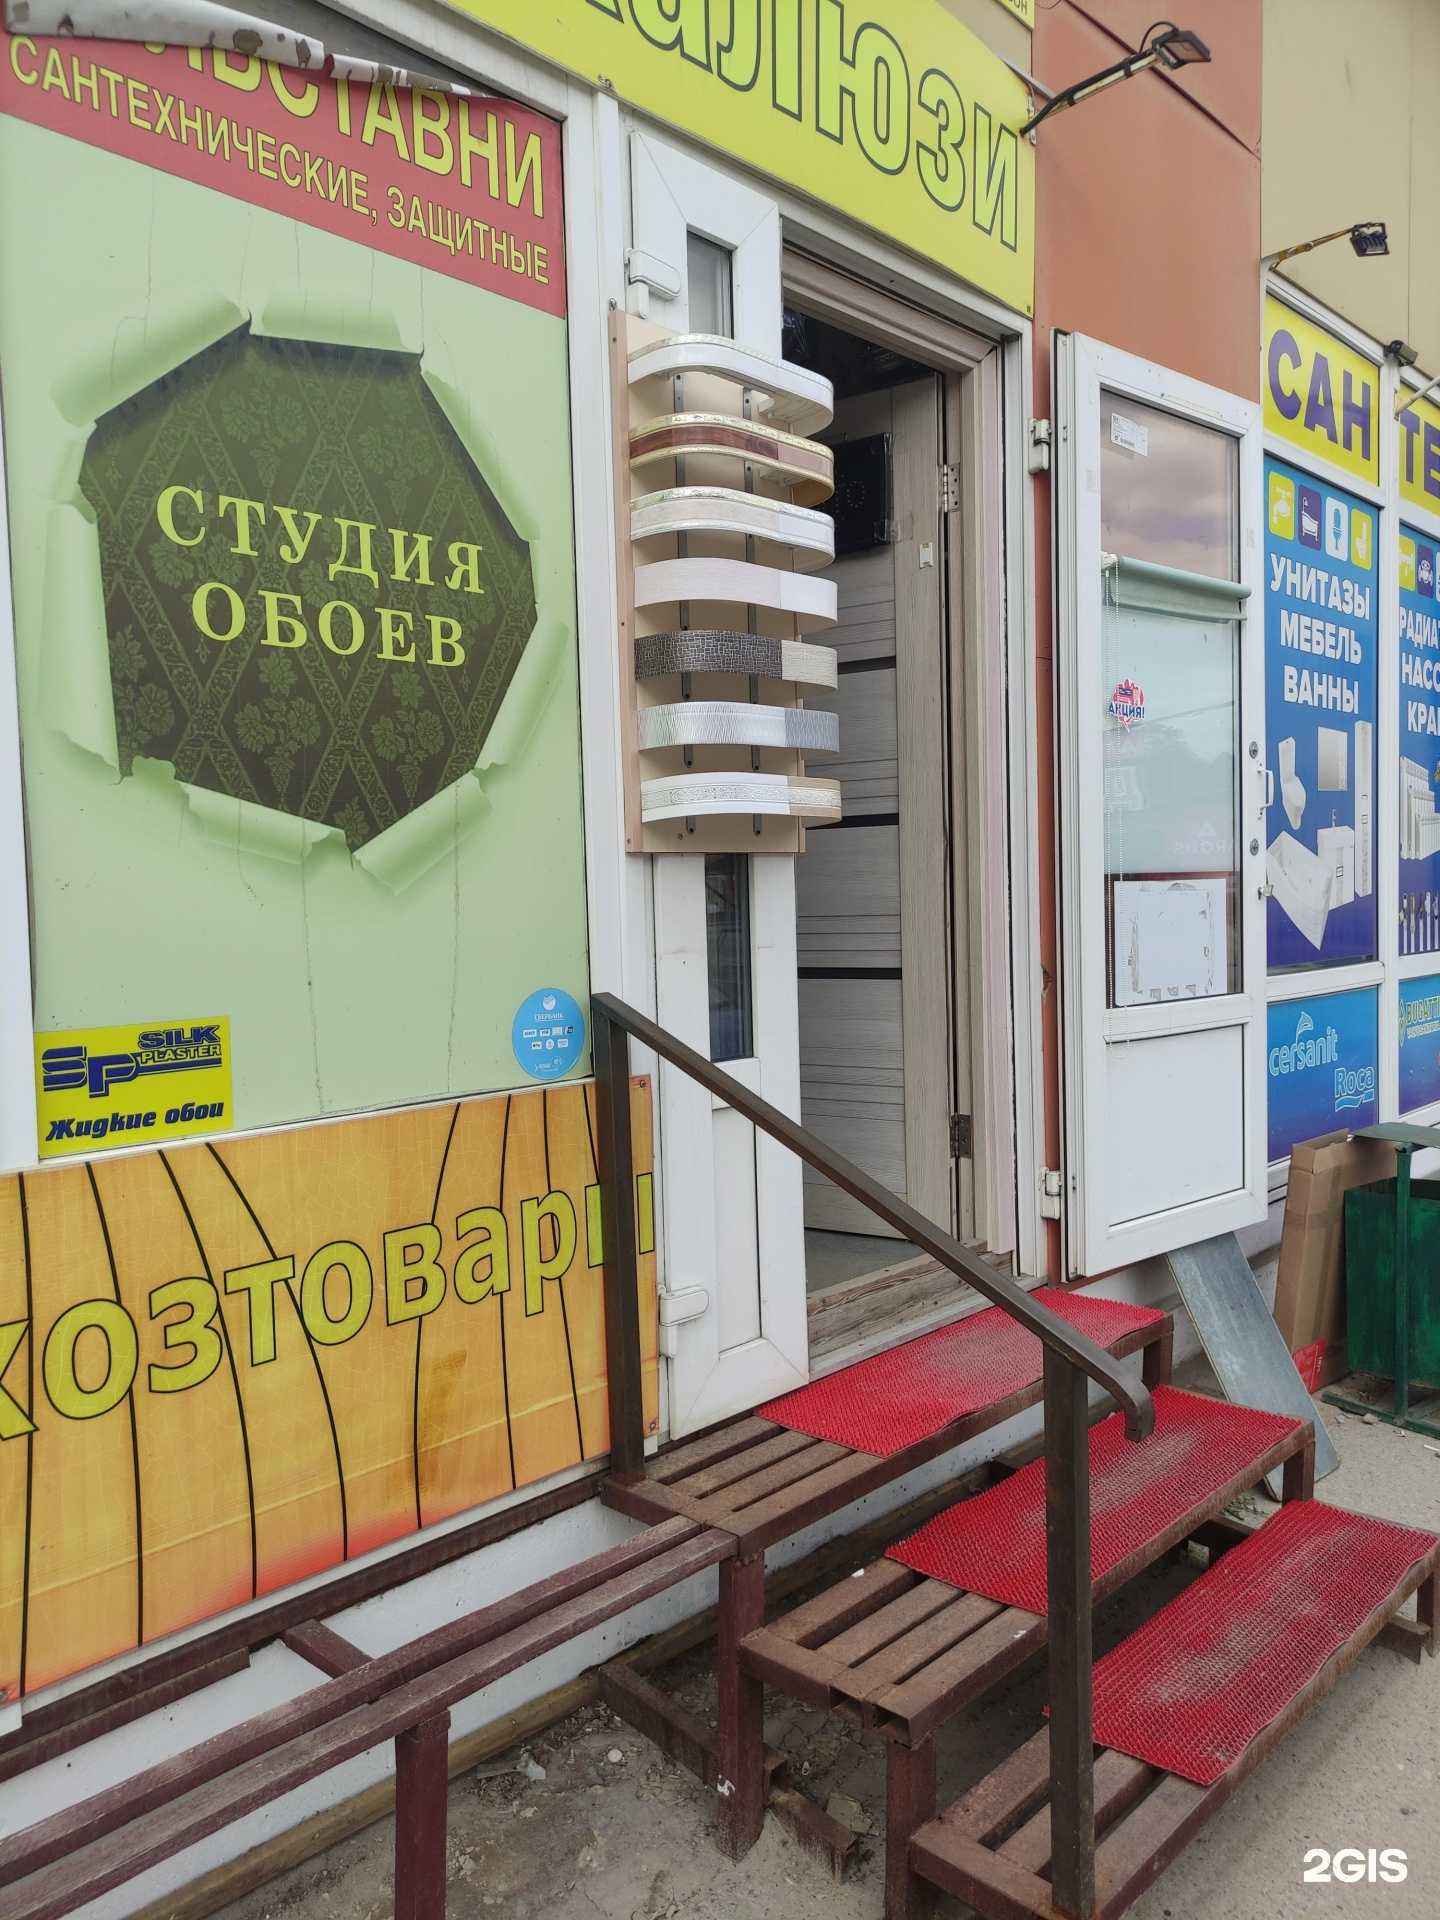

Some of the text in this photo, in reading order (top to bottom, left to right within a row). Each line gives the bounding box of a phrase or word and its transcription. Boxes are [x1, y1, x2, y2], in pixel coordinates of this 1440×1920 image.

[9, 35, 550, 285] САНТЕХНИЧЕСКИЕ, ЗАЩИТНЫЕ
[1268, 329, 1371, 461] САН
[156, 485, 485, 594] СТУДИЯ
[1270, 553, 1370, 620] УНИТАЗЫ
[192, 582, 466, 667] ОБОЕВ
[1280, 609, 1362, 664] МЕБЕЛЬ
[1399, 606, 1440, 650] РАДИА
[1109, 702, 1145, 719] АКЦИЯ!
[1284, 665, 1359, 714] ВАННЫ
[1408, 700, 1440, 737] КРА
[138, 1025, 221, 1049] SILK
[139, 1044, 223, 1065] PLASTER
[1269, 1026, 1339, 1077] cersanit
[1335, 1066, 1376, 1098] Roca
[45, 1101, 225, 1142] Жидкие обои
